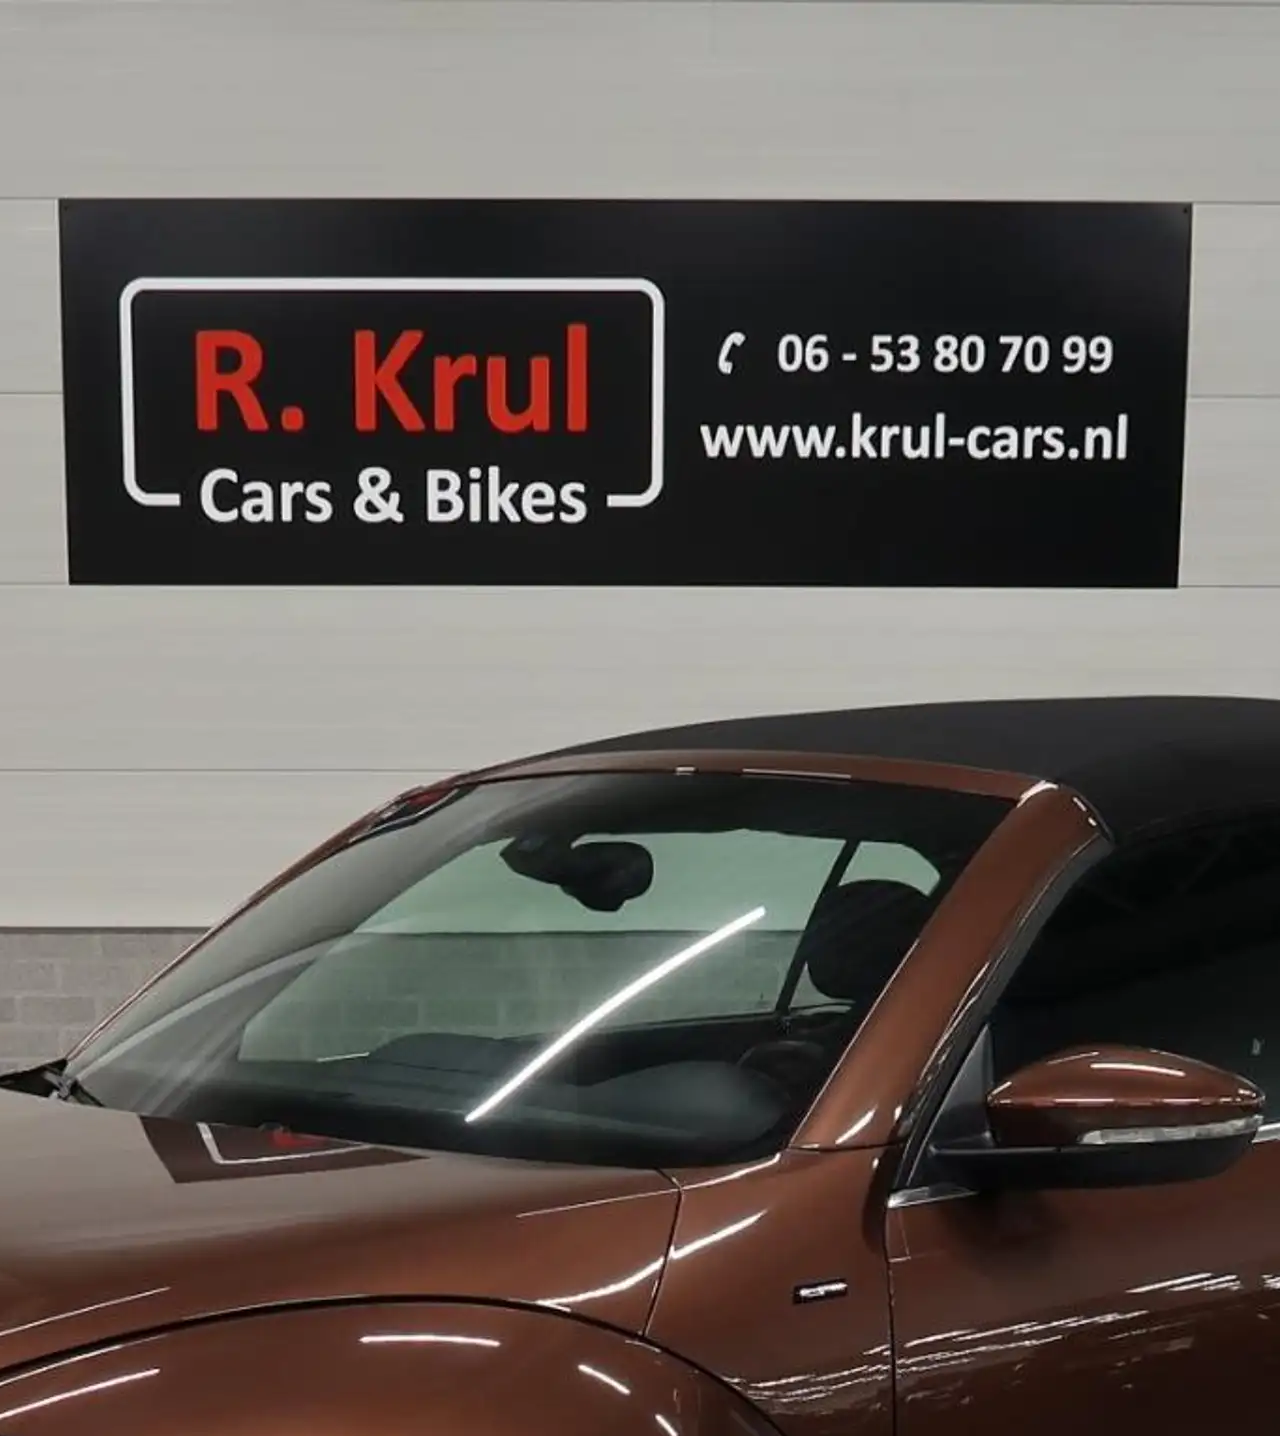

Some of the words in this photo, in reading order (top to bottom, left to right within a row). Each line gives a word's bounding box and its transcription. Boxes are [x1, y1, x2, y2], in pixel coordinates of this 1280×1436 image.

[194, 329, 305, 433] R.
[353, 322, 589, 434] Krul
[777, 333, 830, 374] 06
[869, 333, 922, 374] 53
[932, 333, 987, 374] 80
[998, 334, 1051, 374] 70
[1061, 334, 1114, 375] 99
[698, 411, 1129, 462] www.krul-cars.nl
[199, 467, 334, 524] Cars
[352, 465, 405, 524] &
[425, 464, 588, 525] Bikes
